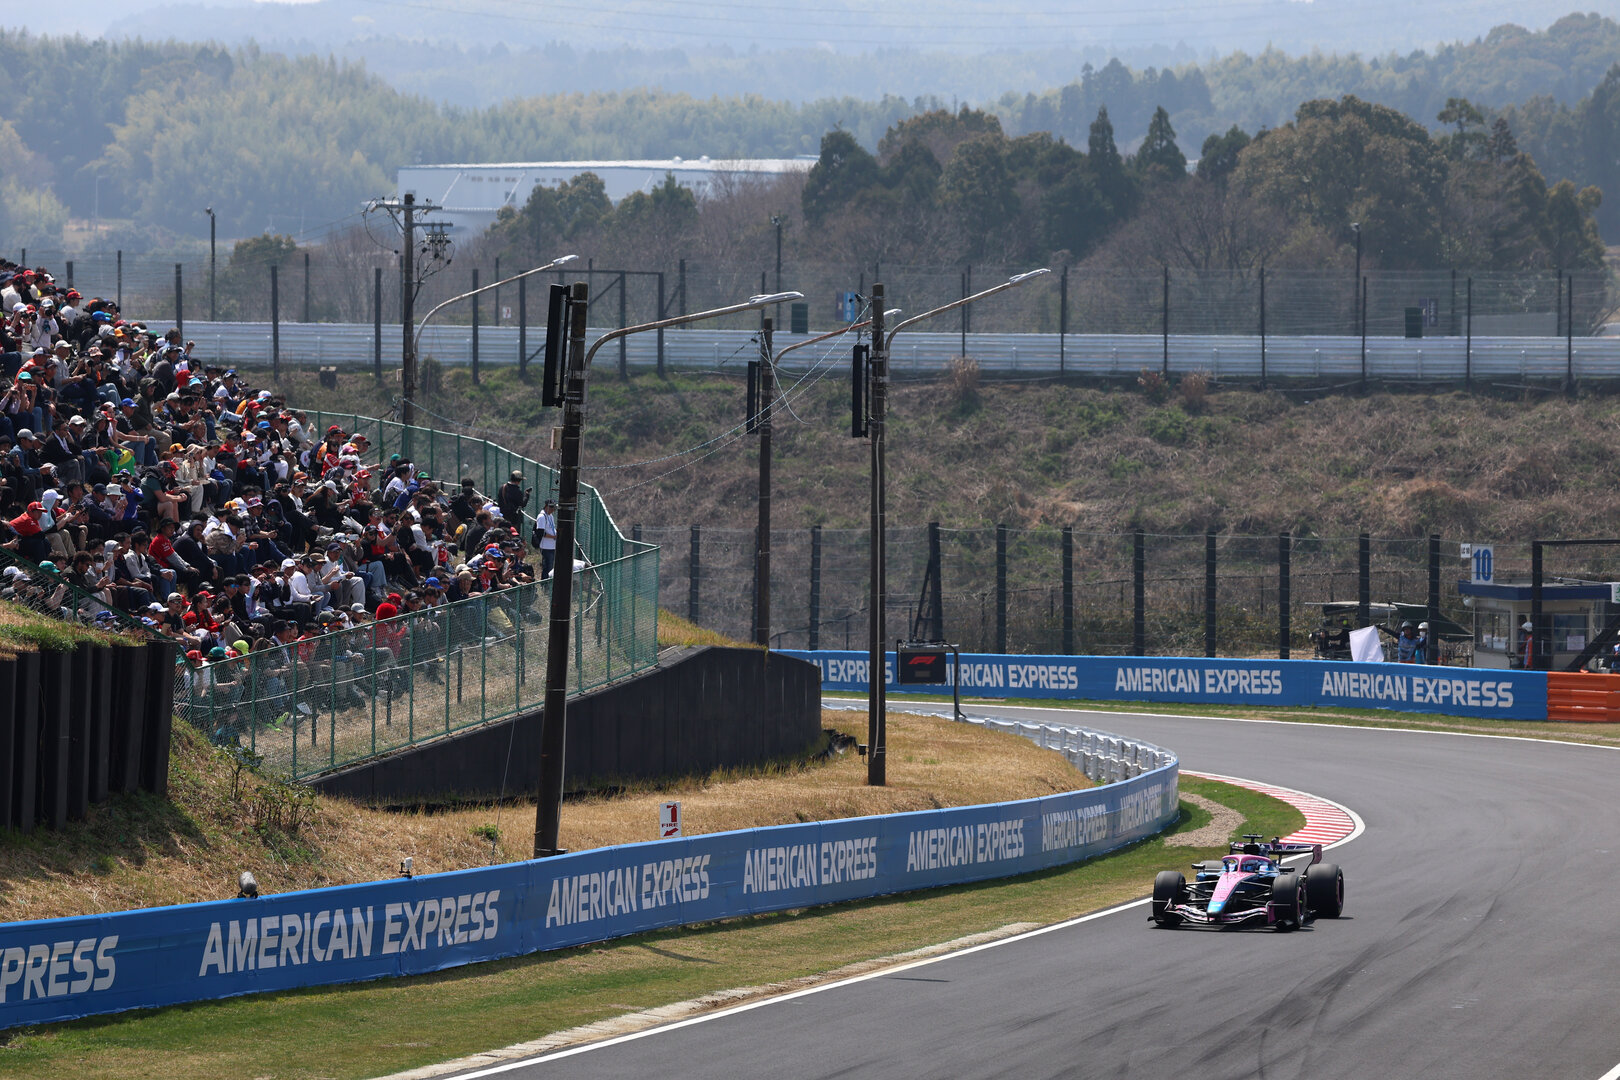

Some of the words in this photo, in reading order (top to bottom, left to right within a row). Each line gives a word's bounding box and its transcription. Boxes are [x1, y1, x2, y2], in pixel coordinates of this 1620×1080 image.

[1473, 548, 1492, 581] 10
[827, 659, 893, 684] EXPRS
[1007, 664, 1079, 690] EXPRESS
[1115, 667, 1200, 693] AMERICAN
[1204, 669, 1282, 695] EXPRESS
[1321, 671, 1407, 701] AMERICAN
[1412, 676, 1514, 708] EXPRESS
[906, 825, 974, 872] AMERICAN
[976, 819, 1025, 863] EXPRESS
[1042, 809, 1077, 852] AMERICAN
[743, 843, 817, 894] AMERICAN
[821, 836, 877, 885] EXPRESS
[545, 866, 638, 929] AMERICAN
[641, 854, 711, 909] EXPRESS
[198, 905, 374, 977] AMERICAN
[381, 889, 500, 955] EXPRESS
[0, 935, 119, 1002] PRESS
